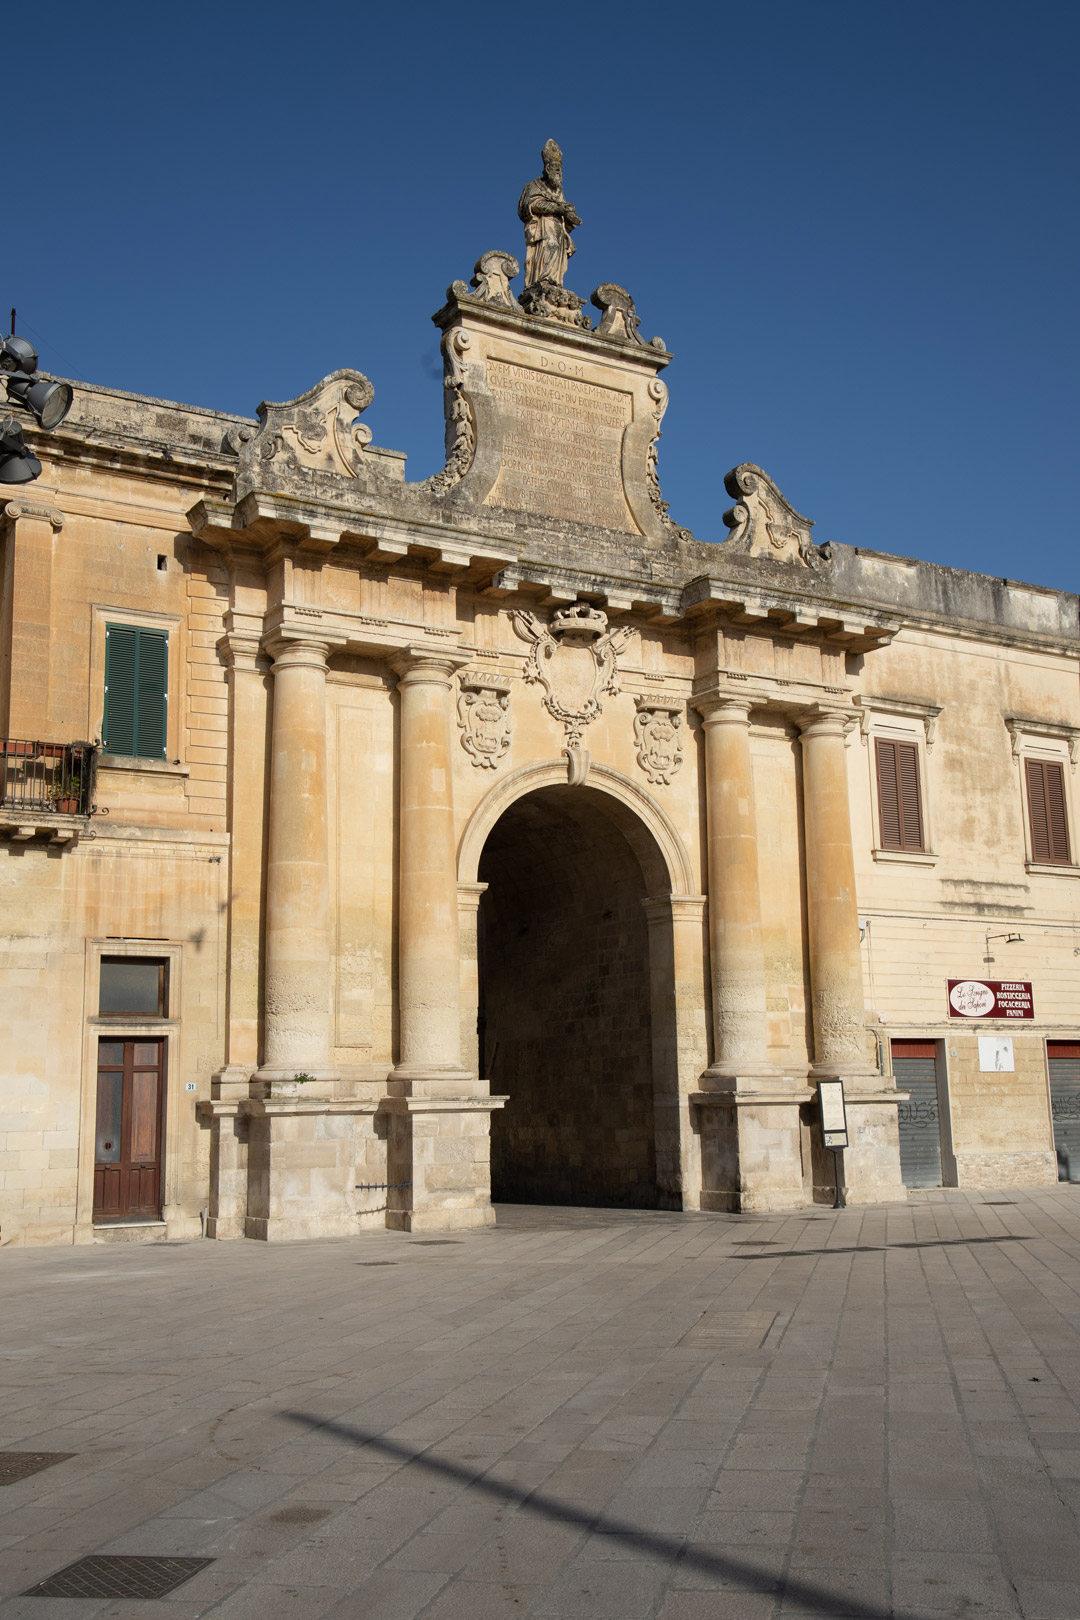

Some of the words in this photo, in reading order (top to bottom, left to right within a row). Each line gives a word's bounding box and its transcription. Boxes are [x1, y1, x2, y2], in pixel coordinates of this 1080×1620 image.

[1001, 983, 1025, 991] PIZZERIA
[996, 992, 1031, 1000] ROSTICCERIA
[1006, 1009, 1024, 1017] PANINI
